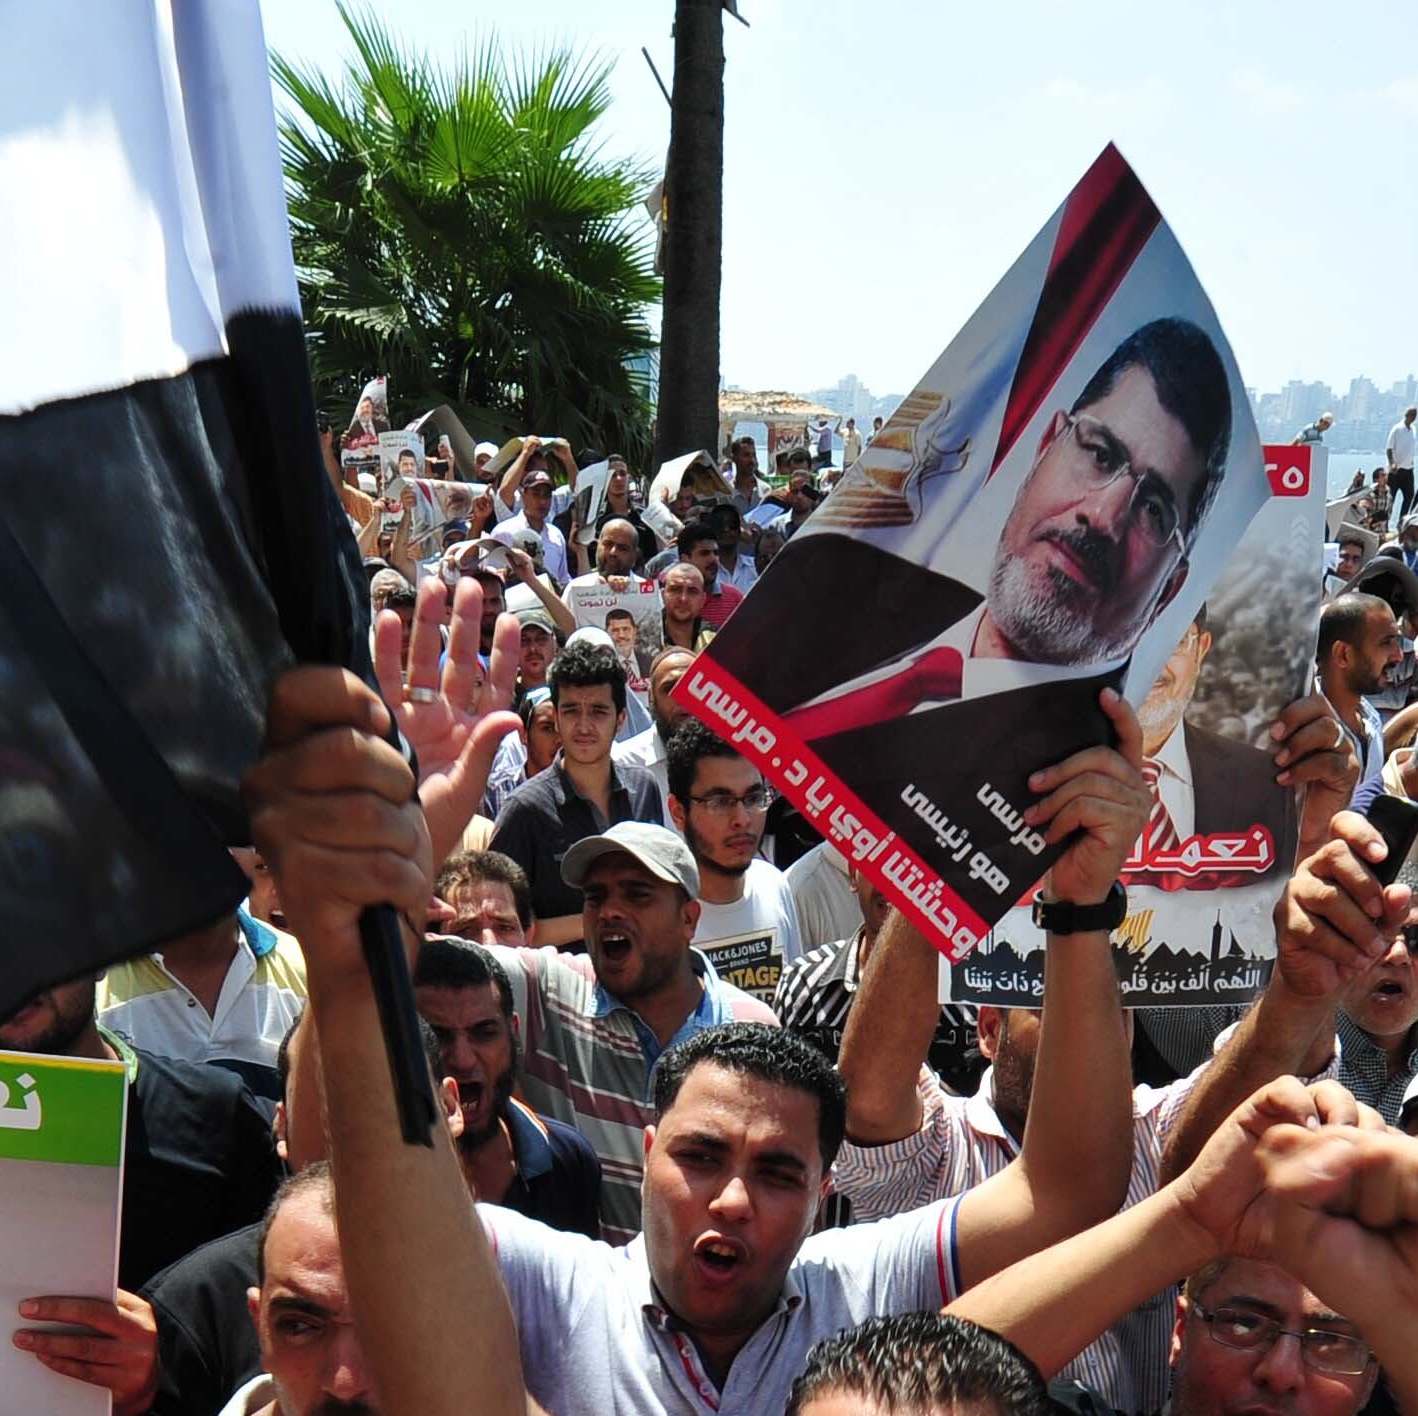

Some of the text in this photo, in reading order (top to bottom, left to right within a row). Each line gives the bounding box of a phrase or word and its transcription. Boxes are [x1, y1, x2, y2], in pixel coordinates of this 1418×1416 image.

[805, 776, 834, 819] يا
[968, 854, 1011, 896] هو
[880, 849, 978, 961] وحشتنا
[721, 965, 781, 989] NTAGE
